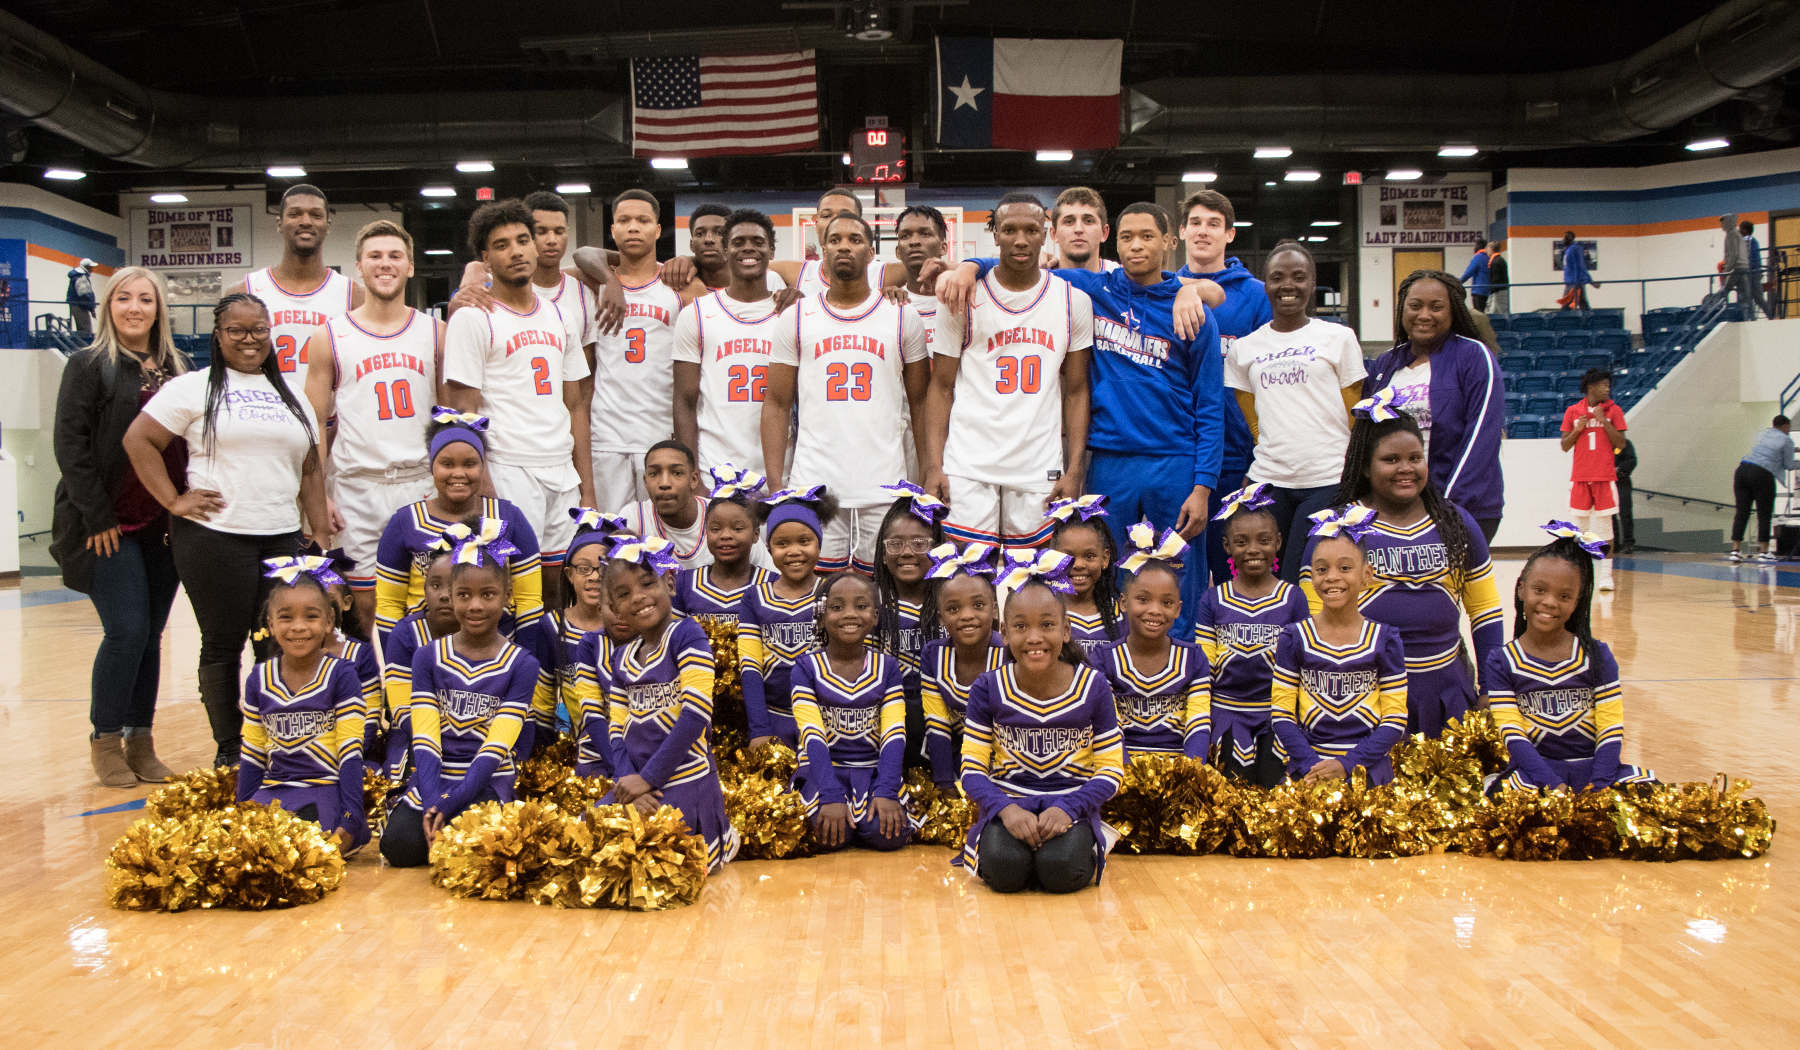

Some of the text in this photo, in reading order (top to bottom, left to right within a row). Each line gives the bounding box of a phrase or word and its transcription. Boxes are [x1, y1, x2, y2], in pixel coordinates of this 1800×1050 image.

[1380, 186, 1467, 201] HOME OF THE
[148, 208, 233, 225] HOME OF THE
[1366, 231, 1483, 244] LADY ROADRUNNERS
[141, 252, 242, 266] ROADRUNNERS
[505, 330, 563, 358] ANGELINA
[625, 327, 646, 363] 3
[716, 338, 772, 362] ANGELI
[814, 334, 886, 361] ANGELINA
[986, 327, 1056, 354] ANGELINA
[355, 352, 426, 382] ANGELINA
[531, 357, 552, 395] 2
[995, 354, 1042, 394] 30
[728, 364, 768, 402] 22
[826, 362, 873, 401] 23
[374, 379, 416, 420] 10
[1587, 431, 1596, 451] 1
[998, 725, 1092, 754] PANTHERS
